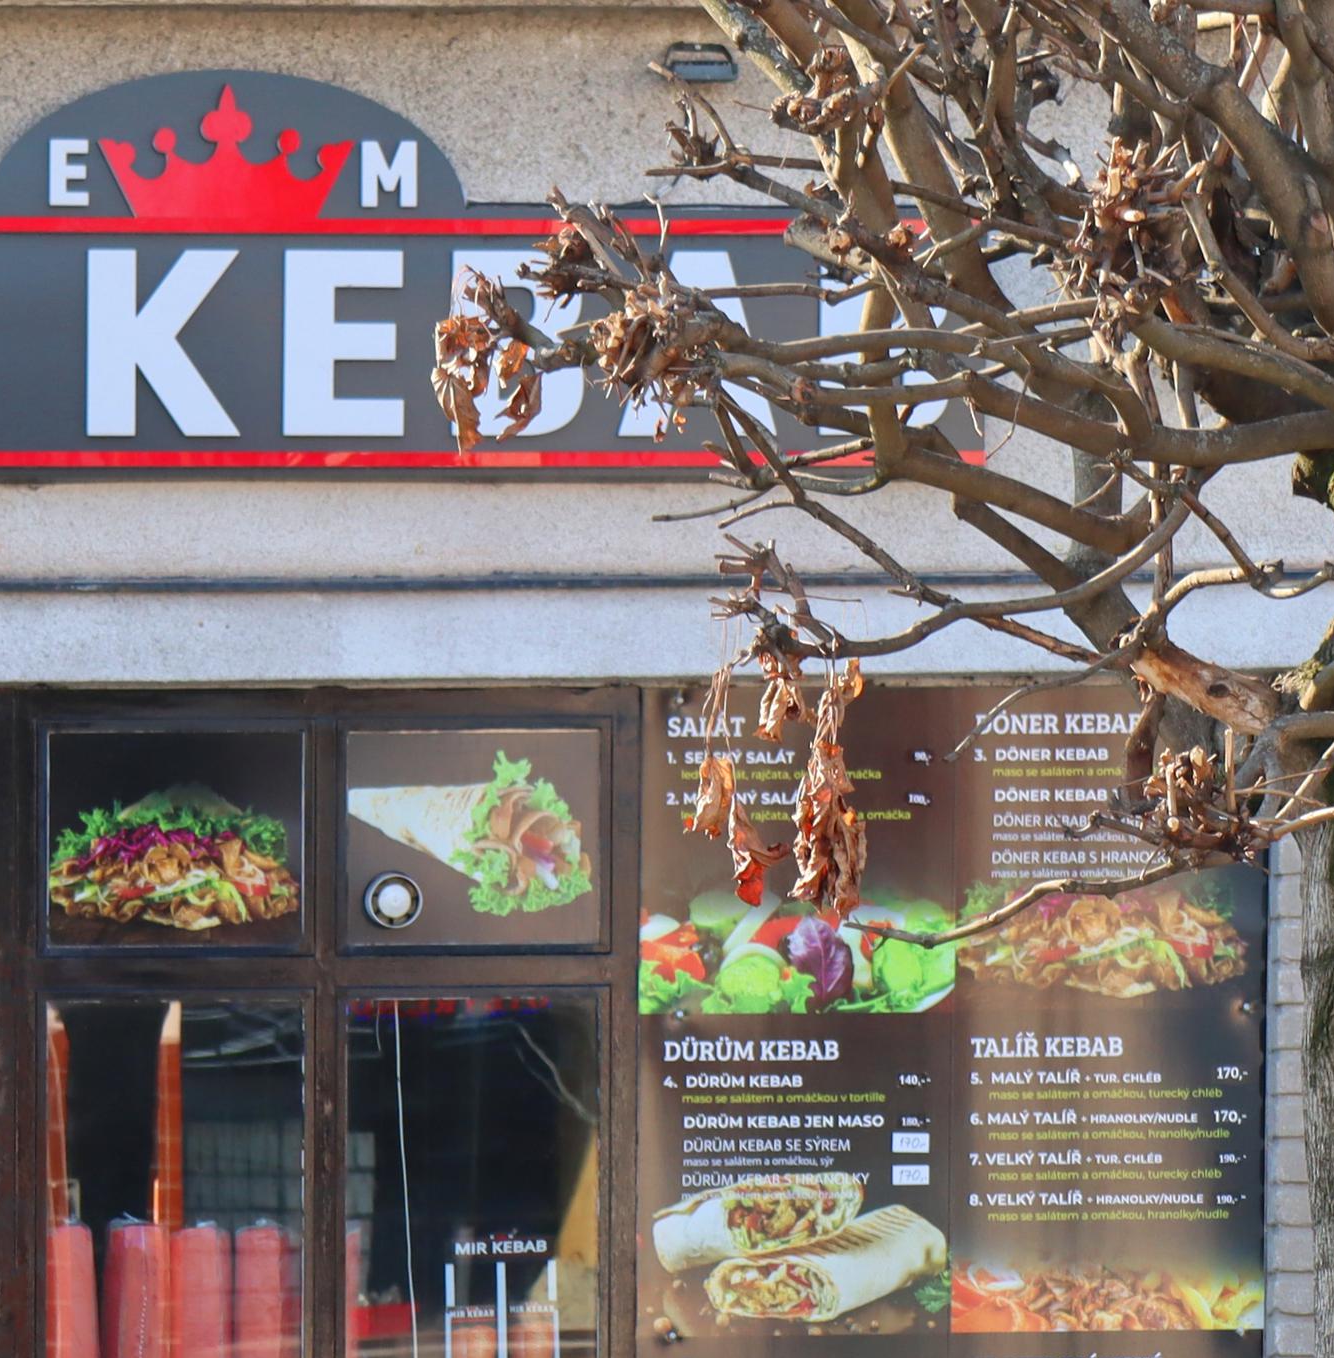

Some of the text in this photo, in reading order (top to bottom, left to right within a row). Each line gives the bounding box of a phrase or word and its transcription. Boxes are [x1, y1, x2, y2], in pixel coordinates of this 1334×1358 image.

[49, 138, 418, 207] E M
[974, 748, 1108, 761] 3. DÖNER KEBAB
[664, 1037, 839, 1062] DÜRÜM KEBAB
[971, 1032, 1124, 1058] TALÍŘ KEBAB
[663, 1076, 677, 1088] 4.
[687, 1074, 744, 1088] DÜRÜM
[750, 1076, 803, 1088] KEBAB
[971, 1072, 982, 1084] 5.
[992, 1068, 1033, 1084] MALÝ
[1037, 1068, 1081, 1083] TALÍŘ
[1094, 1073, 1118, 1083] TUR.
[1123, 1071, 1161, 1083] CHLÉB
[1217, 1067, 1248, 1080] 170,-
[682, 1094, 711, 1103] maso
[715, 1094, 727, 1103] se
[731, 1093, 773, 1102] salátem
[777, 1094, 783, 1102] a
[841, 1094, 847, 1102] v
[684, 1113, 743, 1128] DÜRÜM
[747, 1116, 800, 1128] KEBAB
[805, 1116, 833, 1128] JEN
[839, 1115, 884, 1128] MASO
[971, 1113, 983, 1124] 6.
[988, 1110, 1029, 1124] MALÝ
[1034, 1109, 1077, 1124] TALÍŘ
[1214, 1111, 1246, 1124] 170,-
[683, 1136, 850, 1152] DÜRÜM KEBAB SE SÝREM
[455, 1240, 547, 1255] MIR KEBAB
